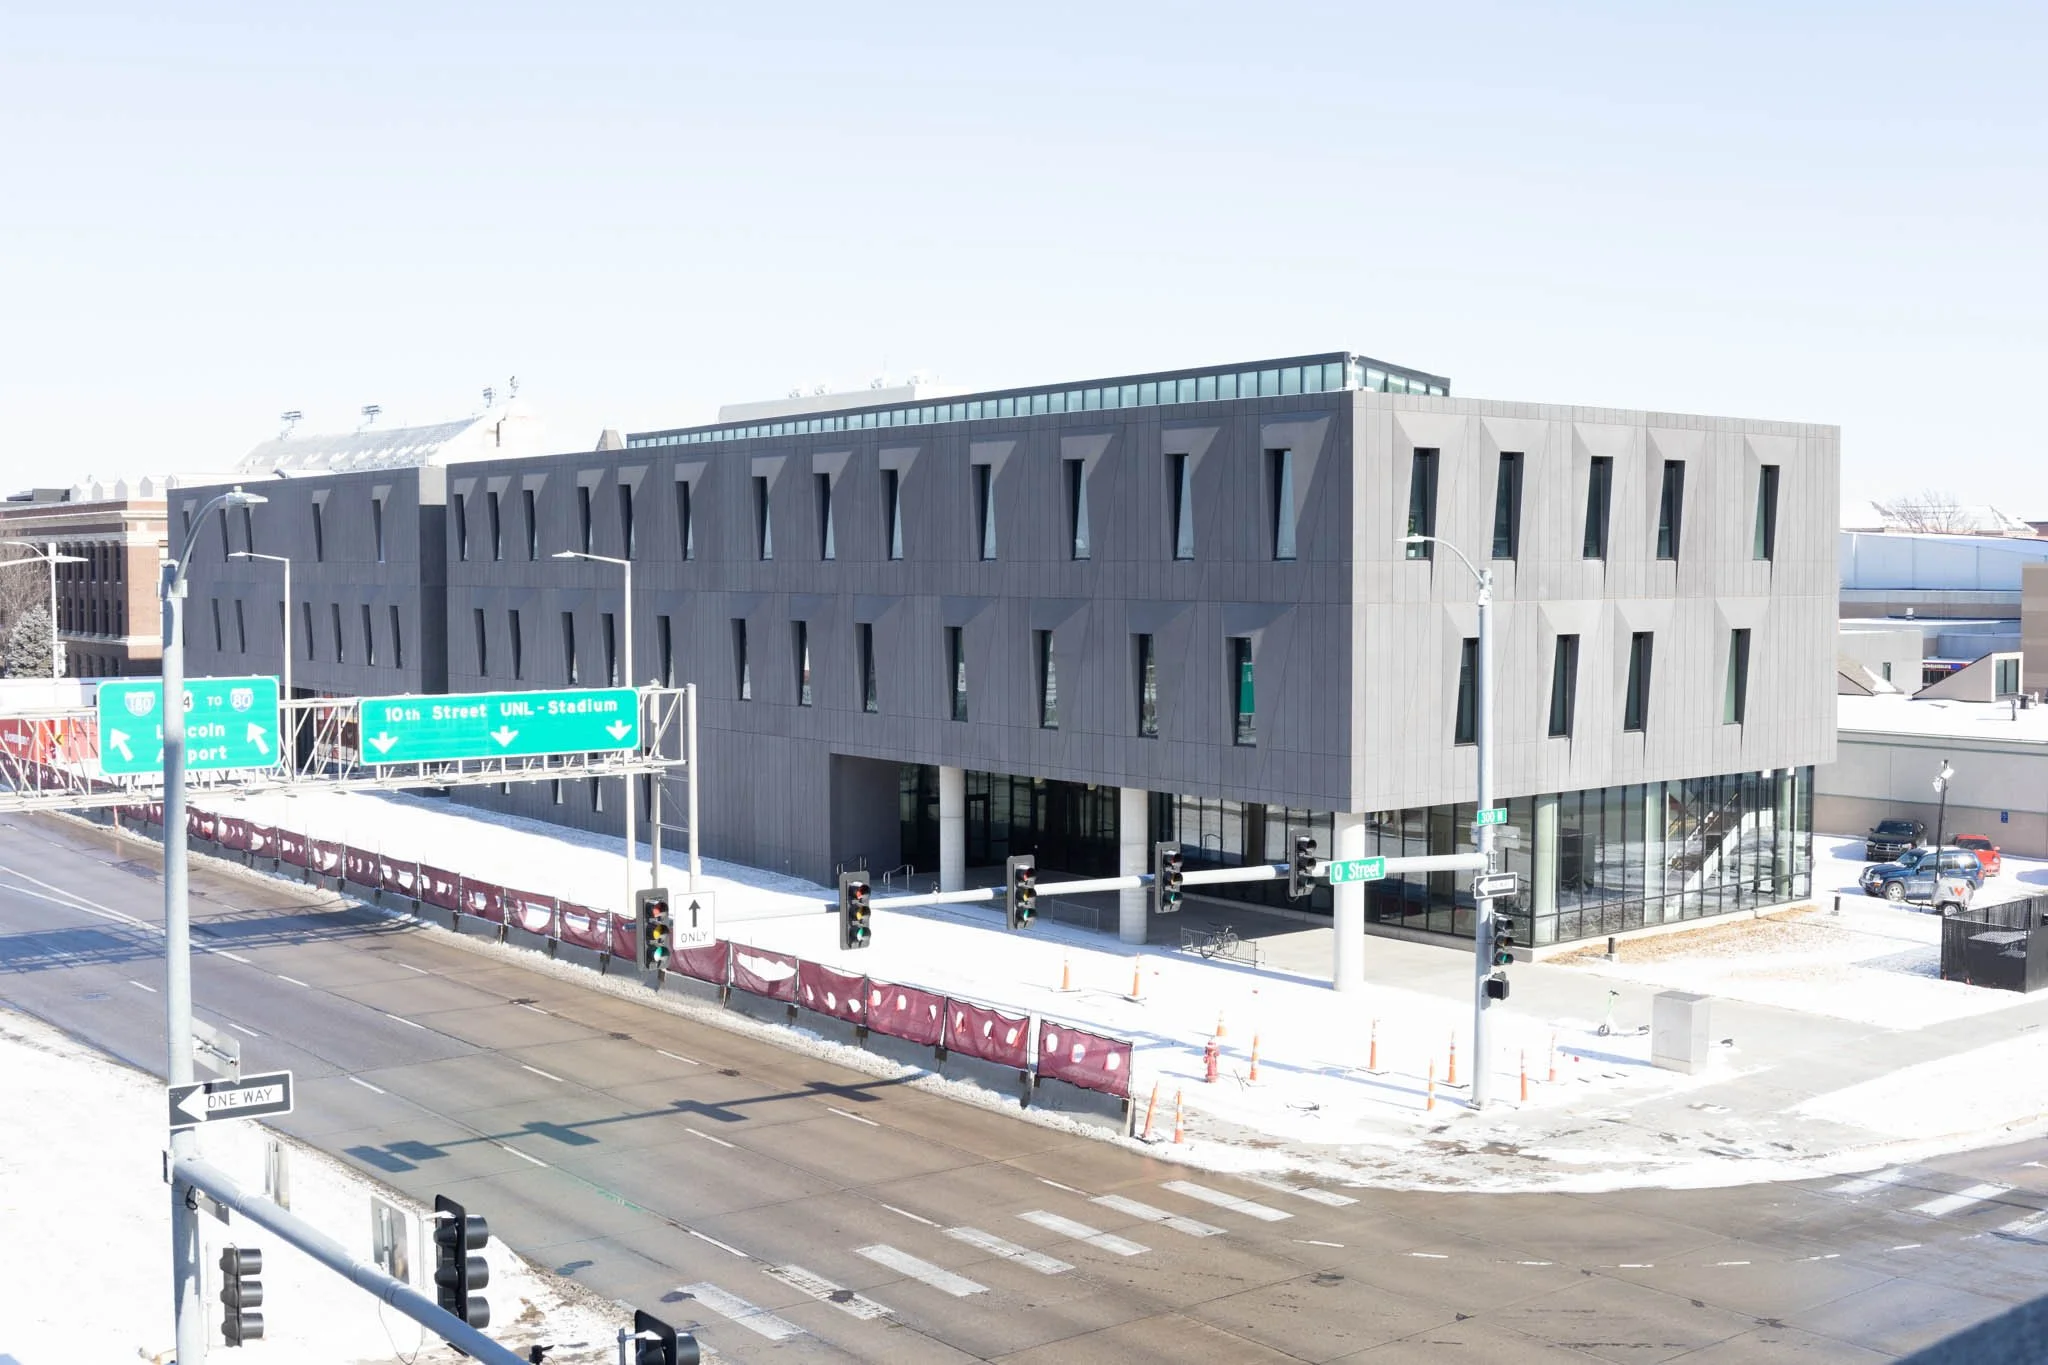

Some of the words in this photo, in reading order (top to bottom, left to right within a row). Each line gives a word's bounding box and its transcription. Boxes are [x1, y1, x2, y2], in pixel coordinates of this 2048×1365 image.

[206, 695, 222, 706] TO
[232, 694, 251, 706] 80
[385, 707, 420, 721] 10th
[432, 704, 487, 720] Street
[500, 702, 534, 716] UNL
[548, 699, 617, 714] Stadium
[156, 722, 225, 740] Lcoln
[1348, 860, 1380, 880] Street
[681, 931, 708, 943] ONLY
[208, 1092, 237, 1108] ONE
[243, 1087, 273, 1103] WAY
